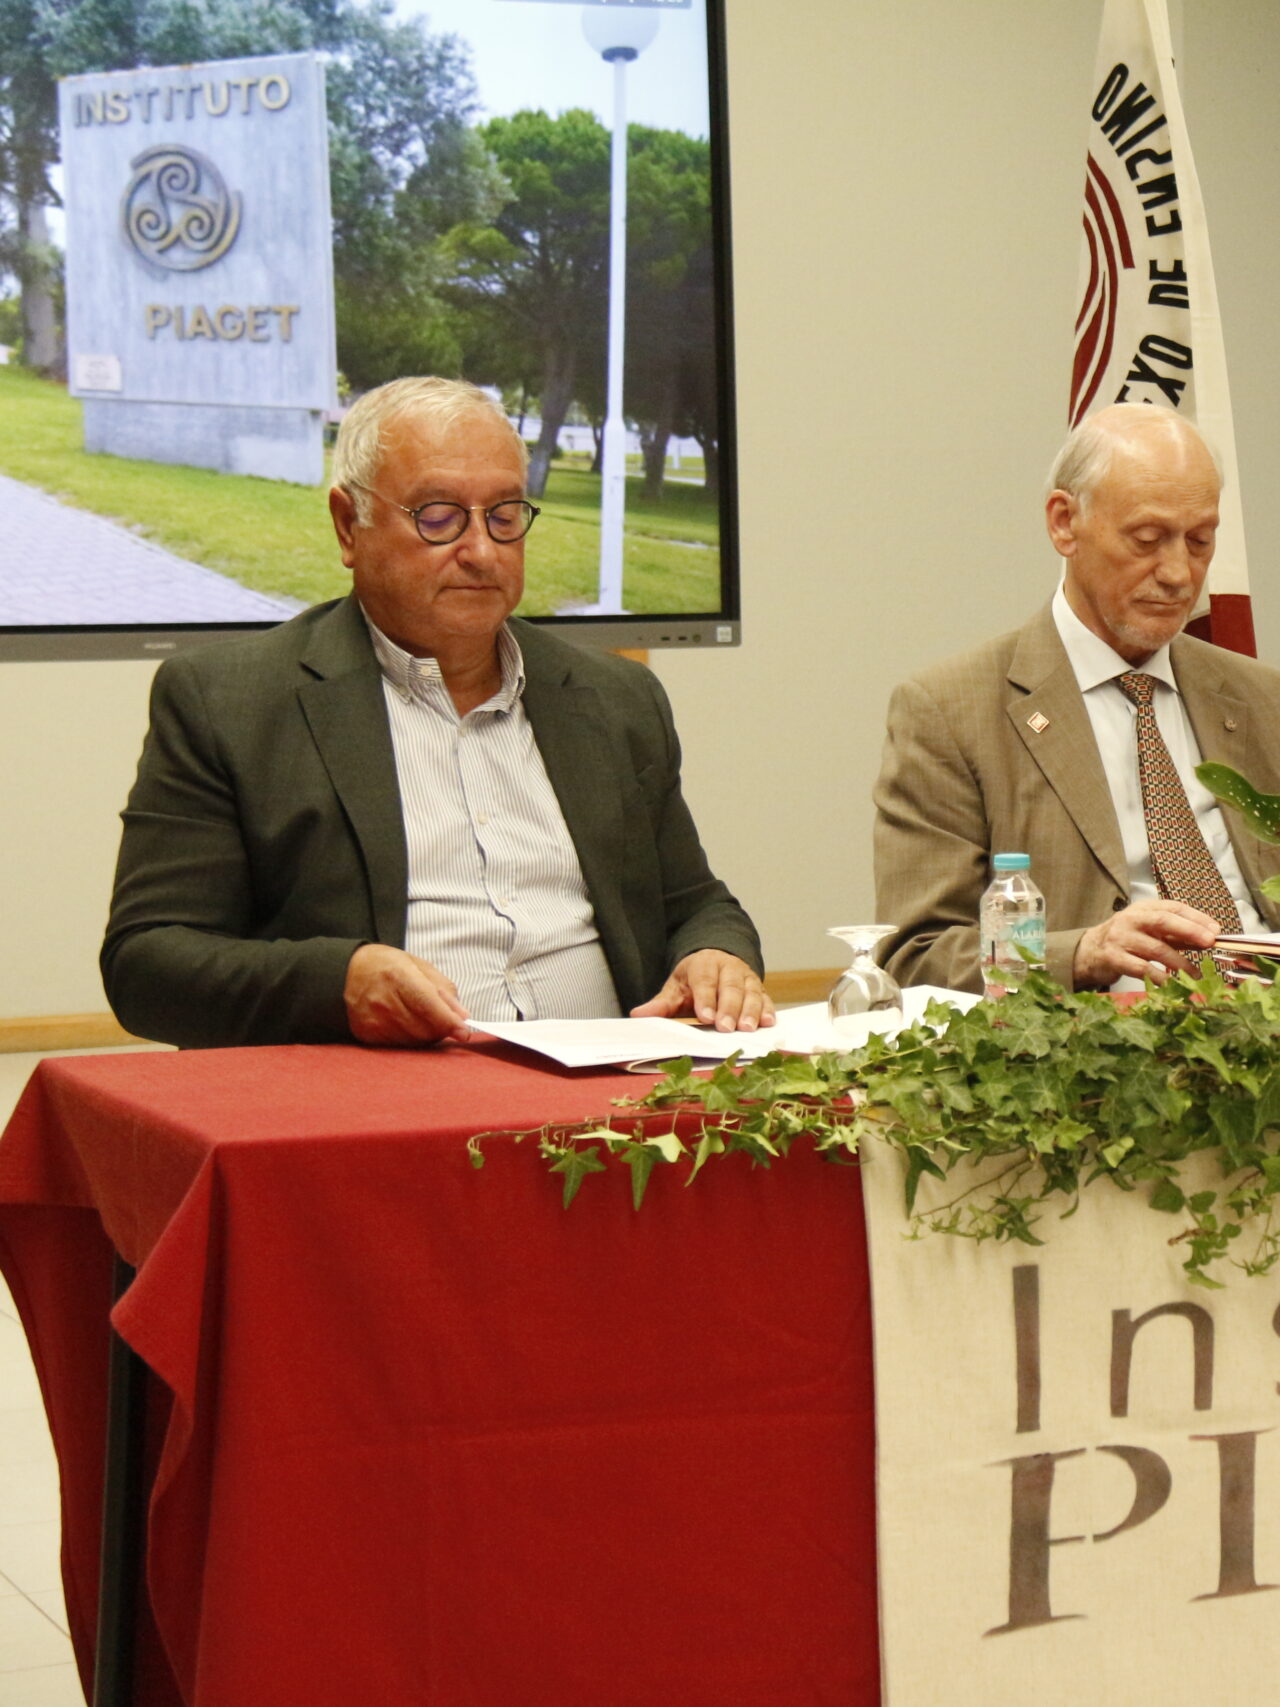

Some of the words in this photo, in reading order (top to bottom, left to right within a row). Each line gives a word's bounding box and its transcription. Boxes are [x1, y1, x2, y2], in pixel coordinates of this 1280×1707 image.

[74, 74, 291, 129] INSTITUTO
[1091, 62, 1183, 237] ENSINO
[1148, 259, 1190, 309] DE
[145, 303, 300, 344] PIAGET
